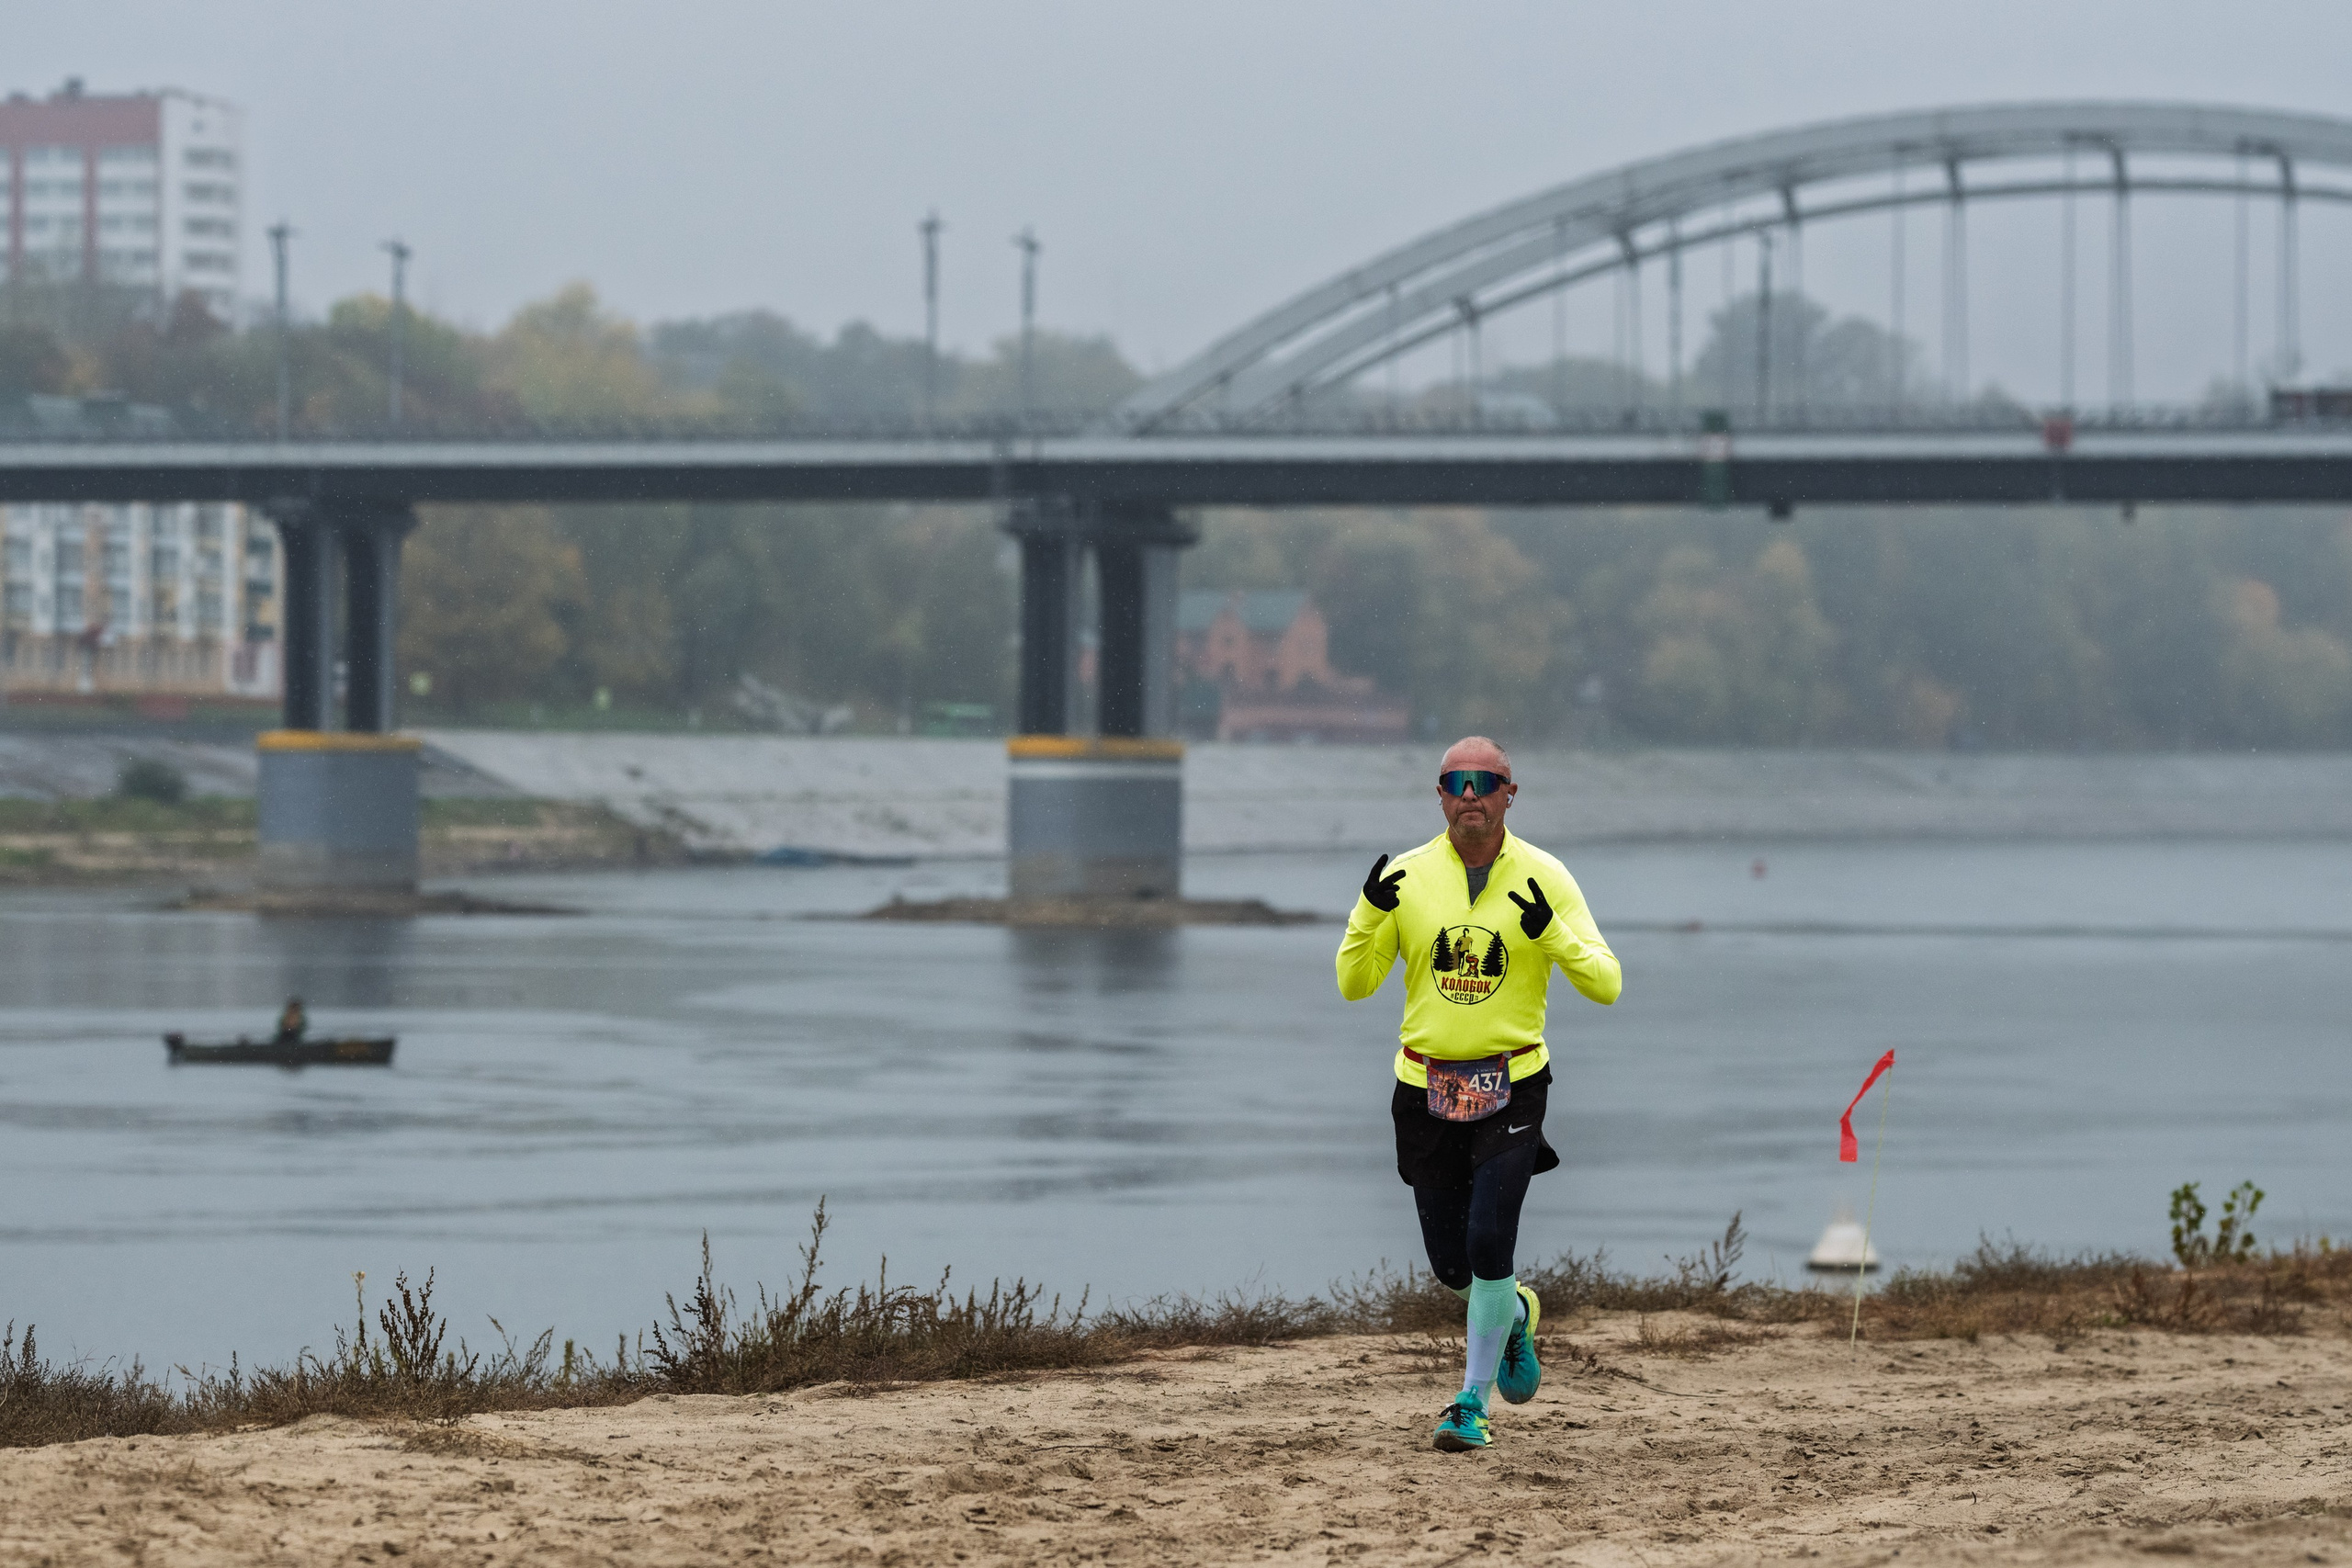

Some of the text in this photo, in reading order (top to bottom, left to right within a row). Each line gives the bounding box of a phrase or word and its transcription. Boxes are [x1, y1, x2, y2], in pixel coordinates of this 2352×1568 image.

[1441, 976, 1491, 994] КОЛОБОК
[1454, 992, 1475, 1003] СССР
[1468, 1071, 1503, 1093] 437
